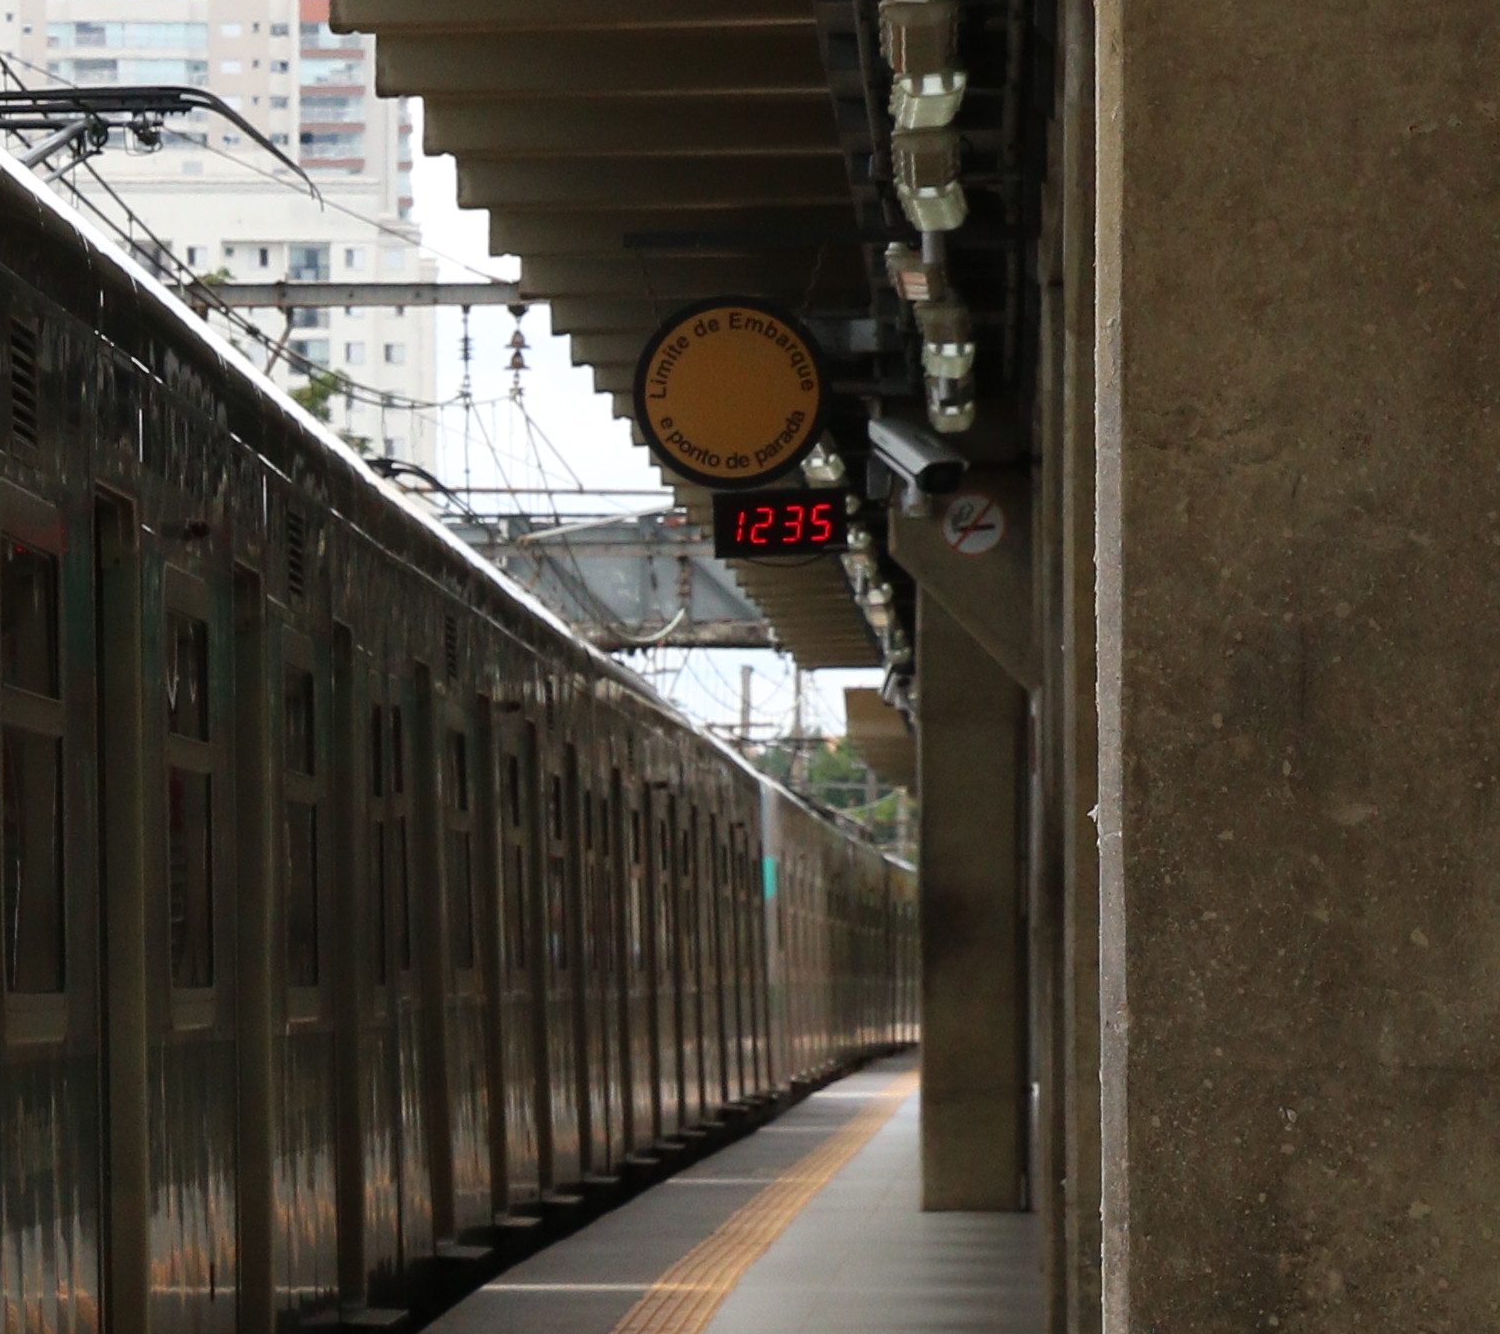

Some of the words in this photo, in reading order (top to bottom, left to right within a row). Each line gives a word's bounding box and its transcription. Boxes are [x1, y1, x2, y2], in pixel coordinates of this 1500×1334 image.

[649, 336, 690, 399] Limite
[694, 318, 721, 338] de
[729, 312, 814, 392] Embarque
[661, 418, 673, 429] e
[754, 410, 806, 468] parada
[665, 431, 721, 468] ponto
[725, 452, 750, 469] de
[736, 503, 833, 544] 1235
